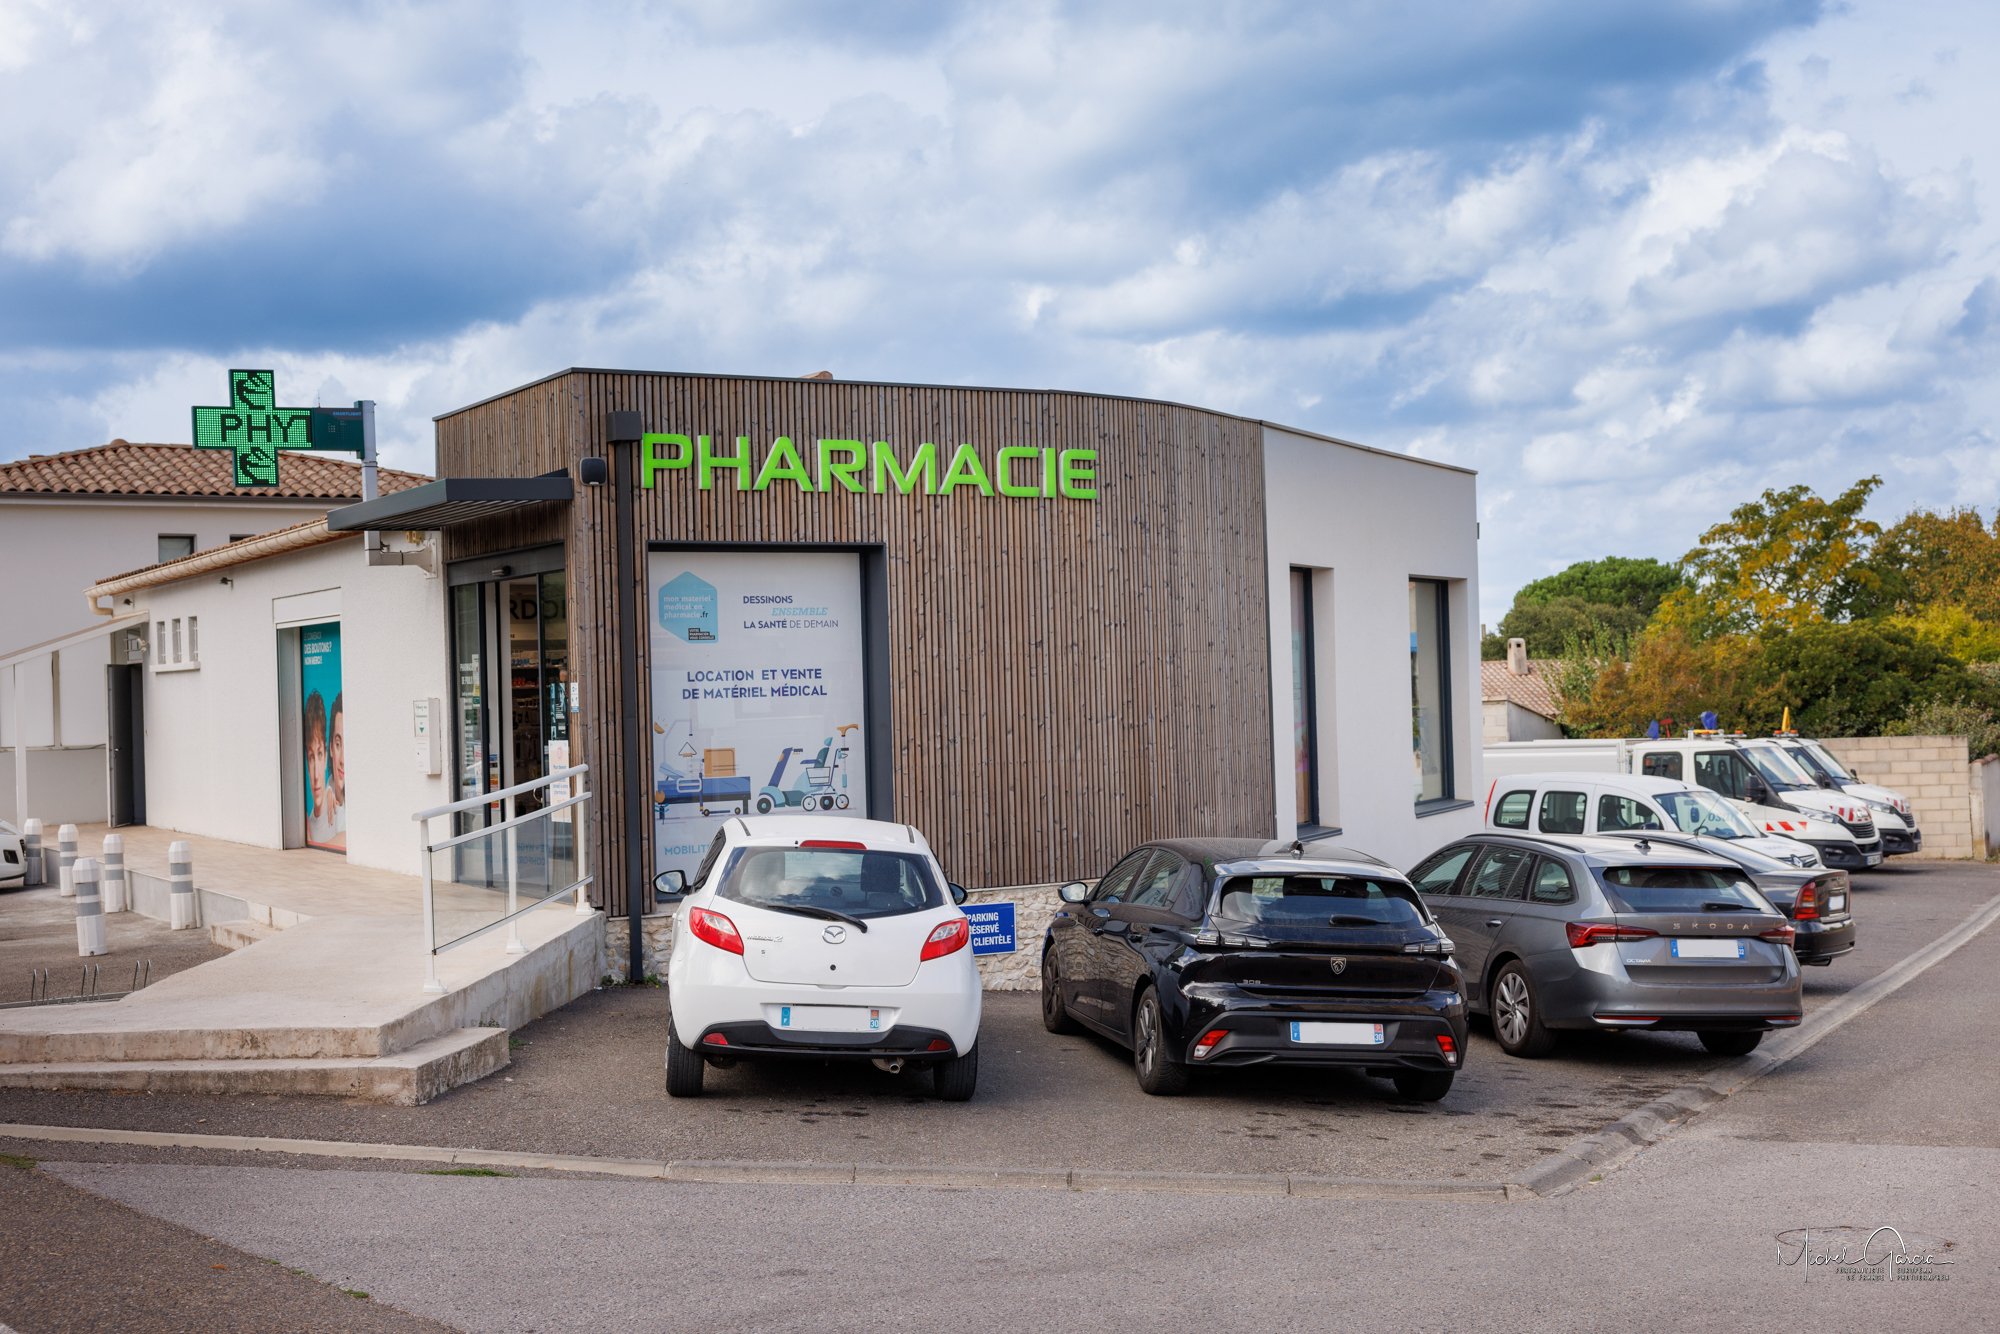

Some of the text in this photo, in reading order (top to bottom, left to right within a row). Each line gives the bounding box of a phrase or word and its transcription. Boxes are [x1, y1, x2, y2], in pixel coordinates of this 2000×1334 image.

[641, 433, 1097, 500] PHARMACIE
[743, 596, 793, 604] DESSINONS
[771, 607, 829, 616] ENSEMBLE
[743, 618, 839, 629] LA SANTÉ DE DEMAIN
[311, 641, 332, 653] BOUTONS?
[687, 668, 822, 682] LOCATION ET VENTE
[682, 683, 828, 700] DE MATÉRIEL MÉDICAL
[664, 844, 709, 856] MOBILIT
[968, 912, 999, 922] PARKING
[973, 934, 1012, 946] CLIENTÈLE
[870, 1019, 880, 1028] 30
[1374, 1033, 1384, 1041] 30
